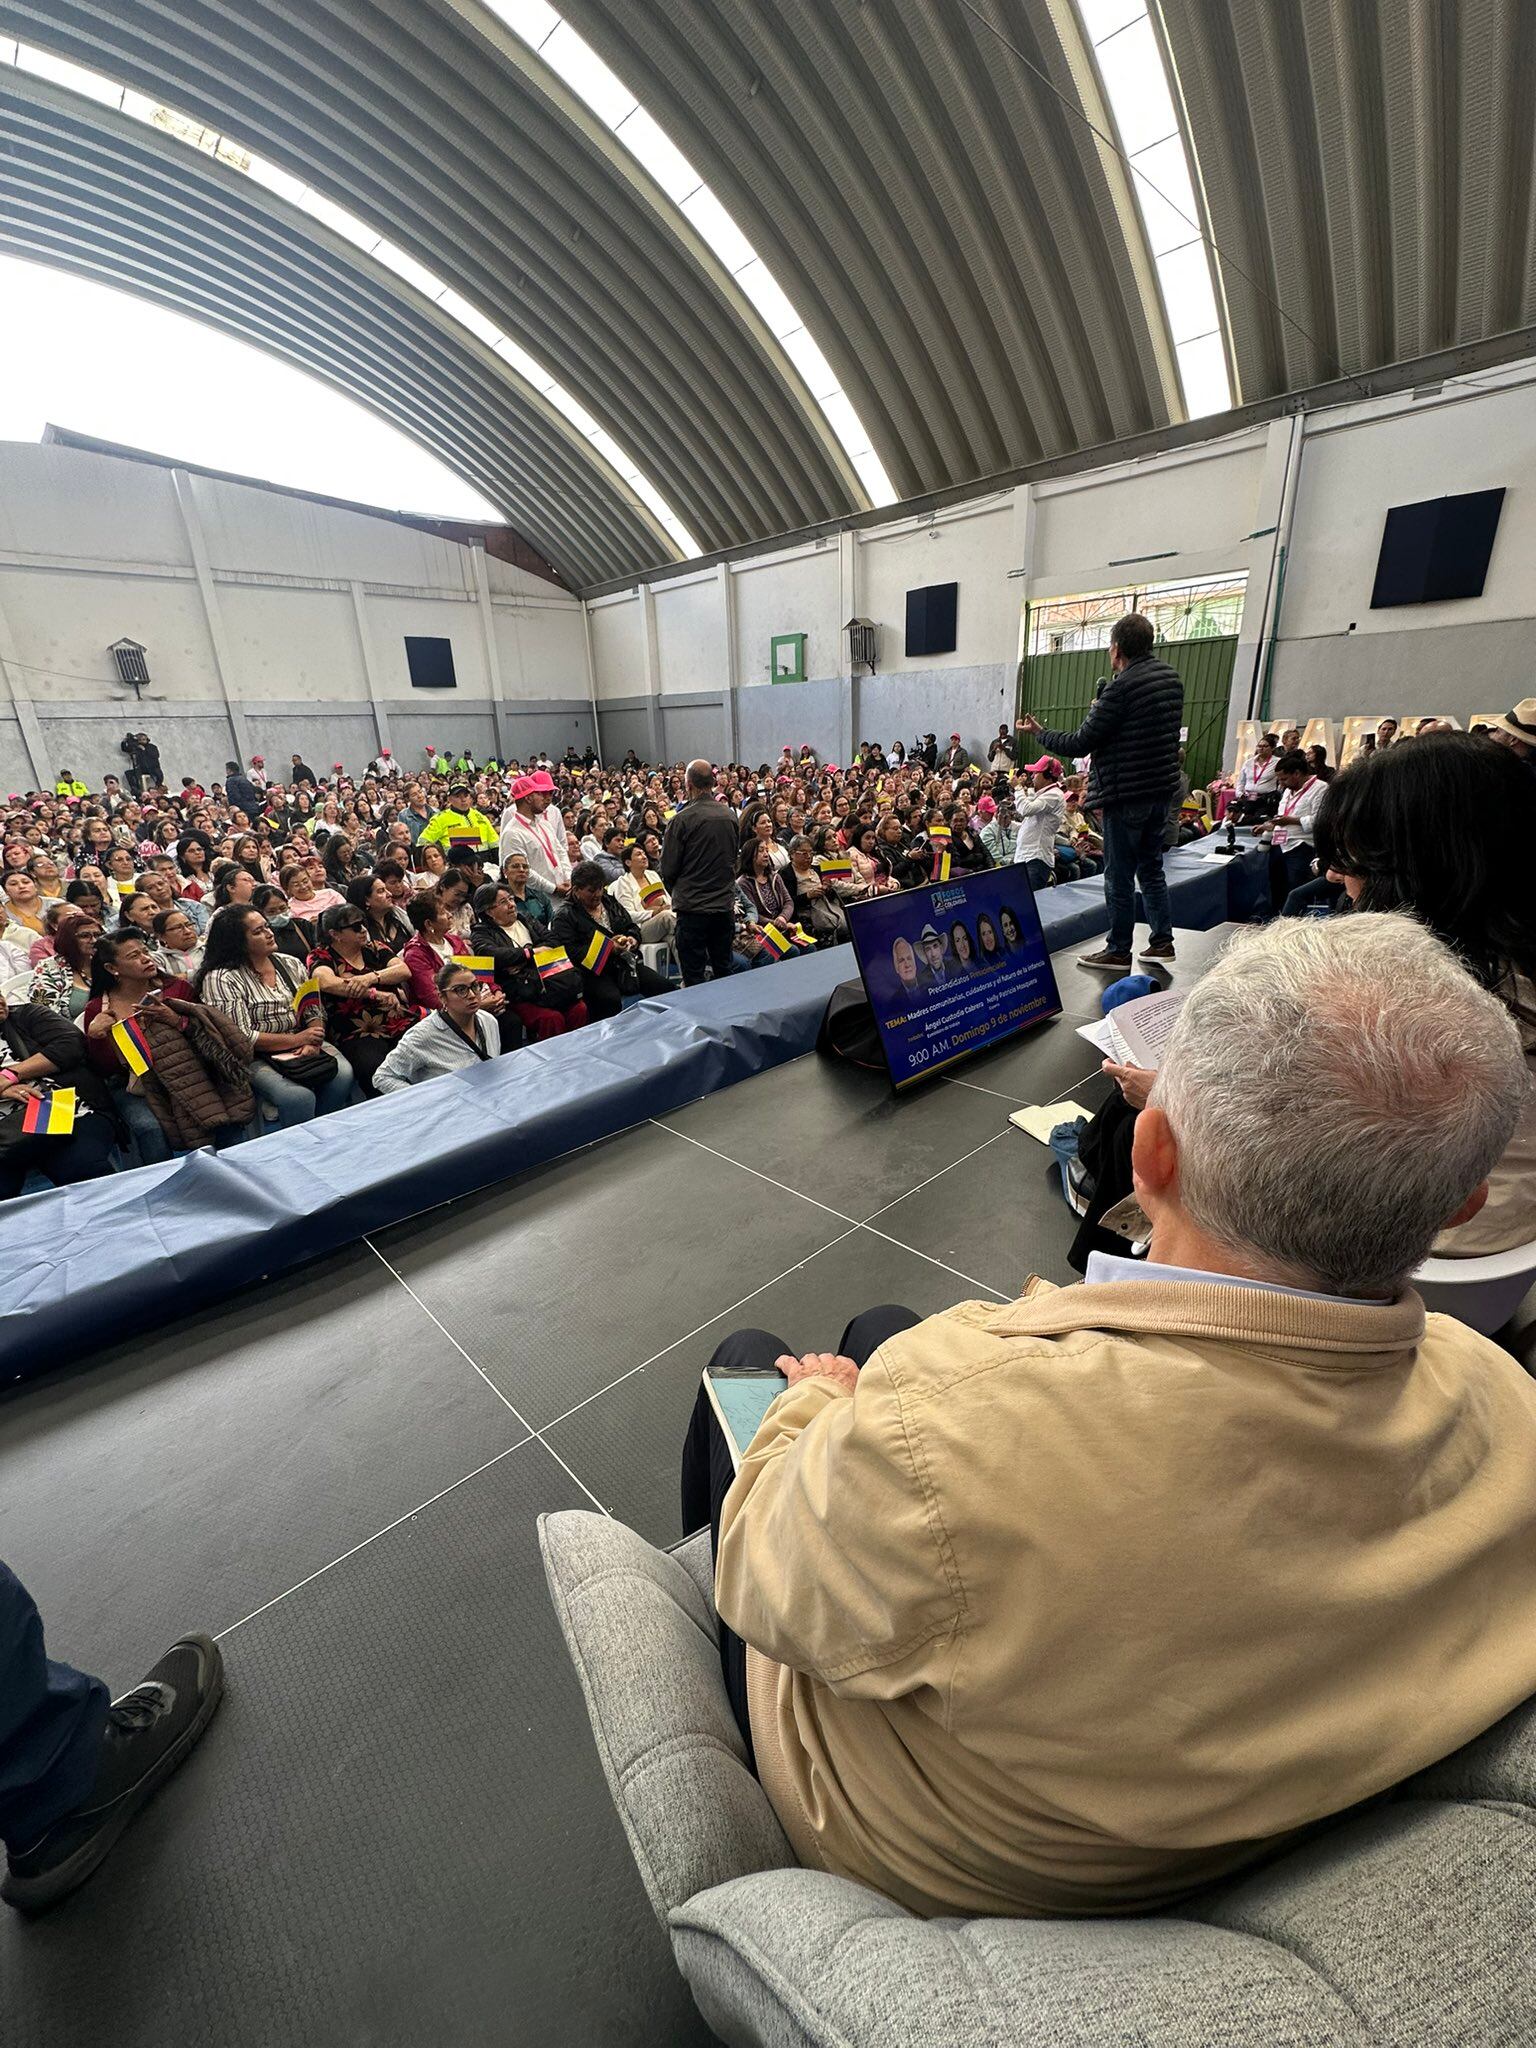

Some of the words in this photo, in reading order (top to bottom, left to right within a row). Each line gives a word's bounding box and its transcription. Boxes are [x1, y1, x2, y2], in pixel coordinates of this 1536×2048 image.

[885, 1016, 907, 1029] TEMA:
[907, 1007, 929, 1020] Madres
[930, 994, 966, 1011] comunitarias,
[966, 982, 993, 996] cuidadoras
[1002, 972, 1016, 981] futuro
[1028, 960, 1045, 970] infancia
[928, 975, 969, 995] Precandidatos
[987, 994, 998, 1003] Nelly
[999, 988, 1016, 998] Patricia
[1016, 978, 1038, 990] Mosquera
[925, 1019, 941, 1031] Ángel
[941, 1009, 964, 1023] Custodio
[965, 1002, 984, 1013] Cabrera
[909, 1049, 929, 1067] 9:00
[932, 1040, 951, 1056] A.M.
[951, 1022, 990, 1046] Domingo
[990, 1018, 997, 1027] 9
[998, 1013, 1008, 1024] de
[1009, 996, 1046, 1019] noviembre
